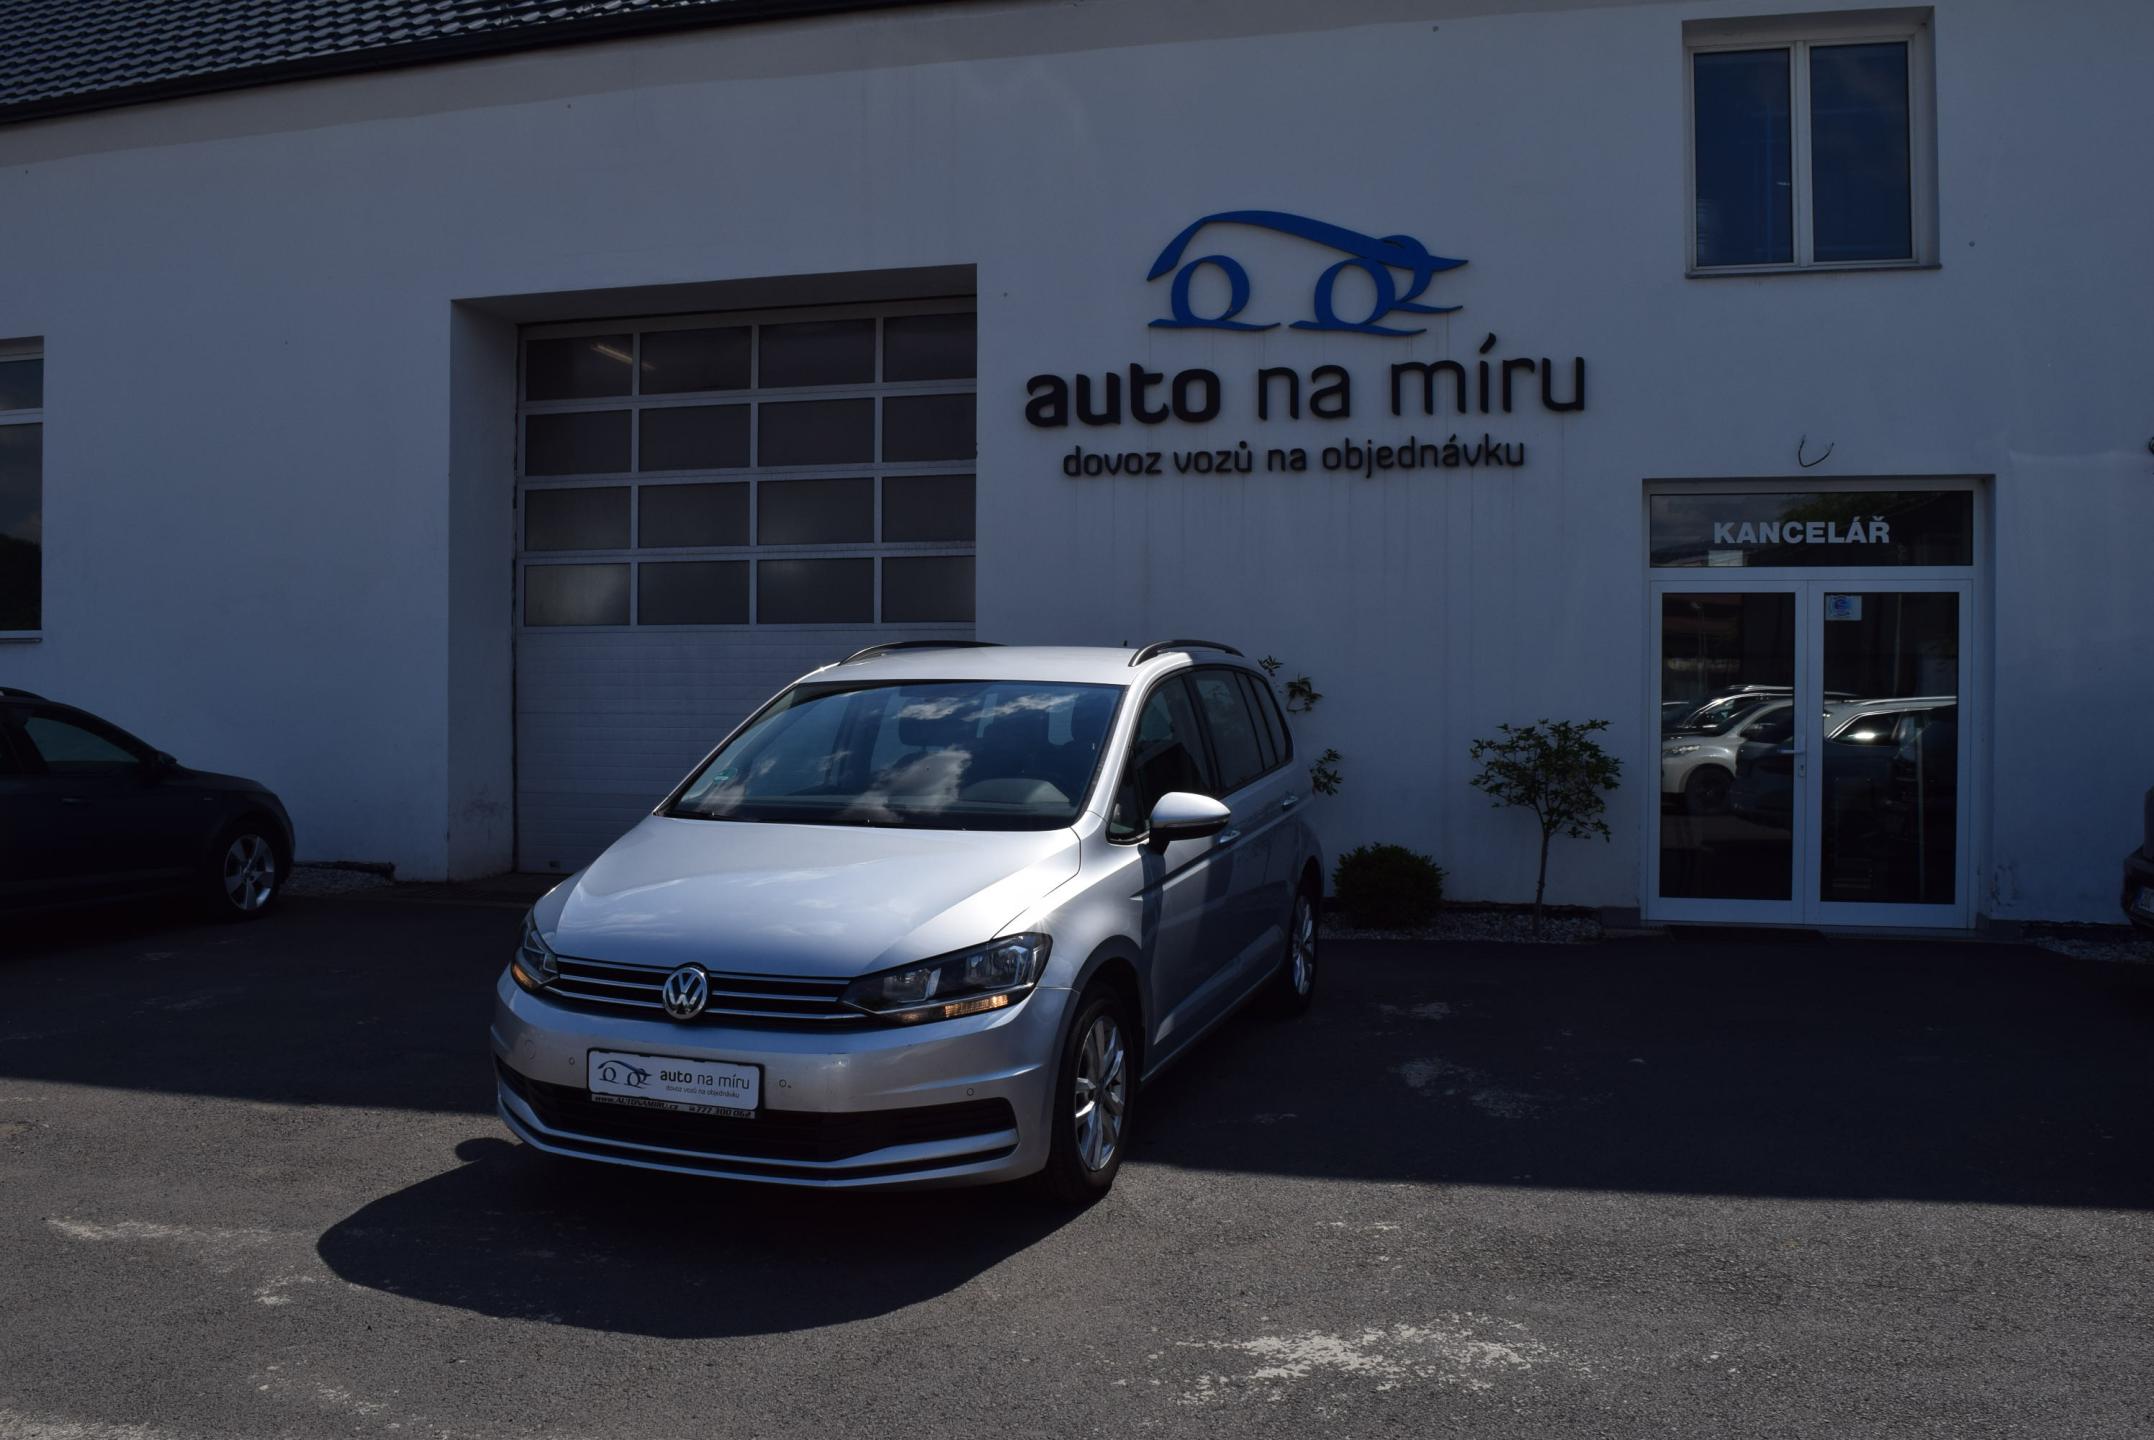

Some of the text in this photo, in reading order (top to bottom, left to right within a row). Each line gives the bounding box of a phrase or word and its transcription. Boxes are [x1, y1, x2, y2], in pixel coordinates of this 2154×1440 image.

[1025, 333, 1585, 427] auto na míru
[1063, 434, 1525, 478] dovoz vozů na objednávku
[1713, 515, 1890, 544] KANCELÁŘ
[660, 1070, 750, 1090] auto na míru
